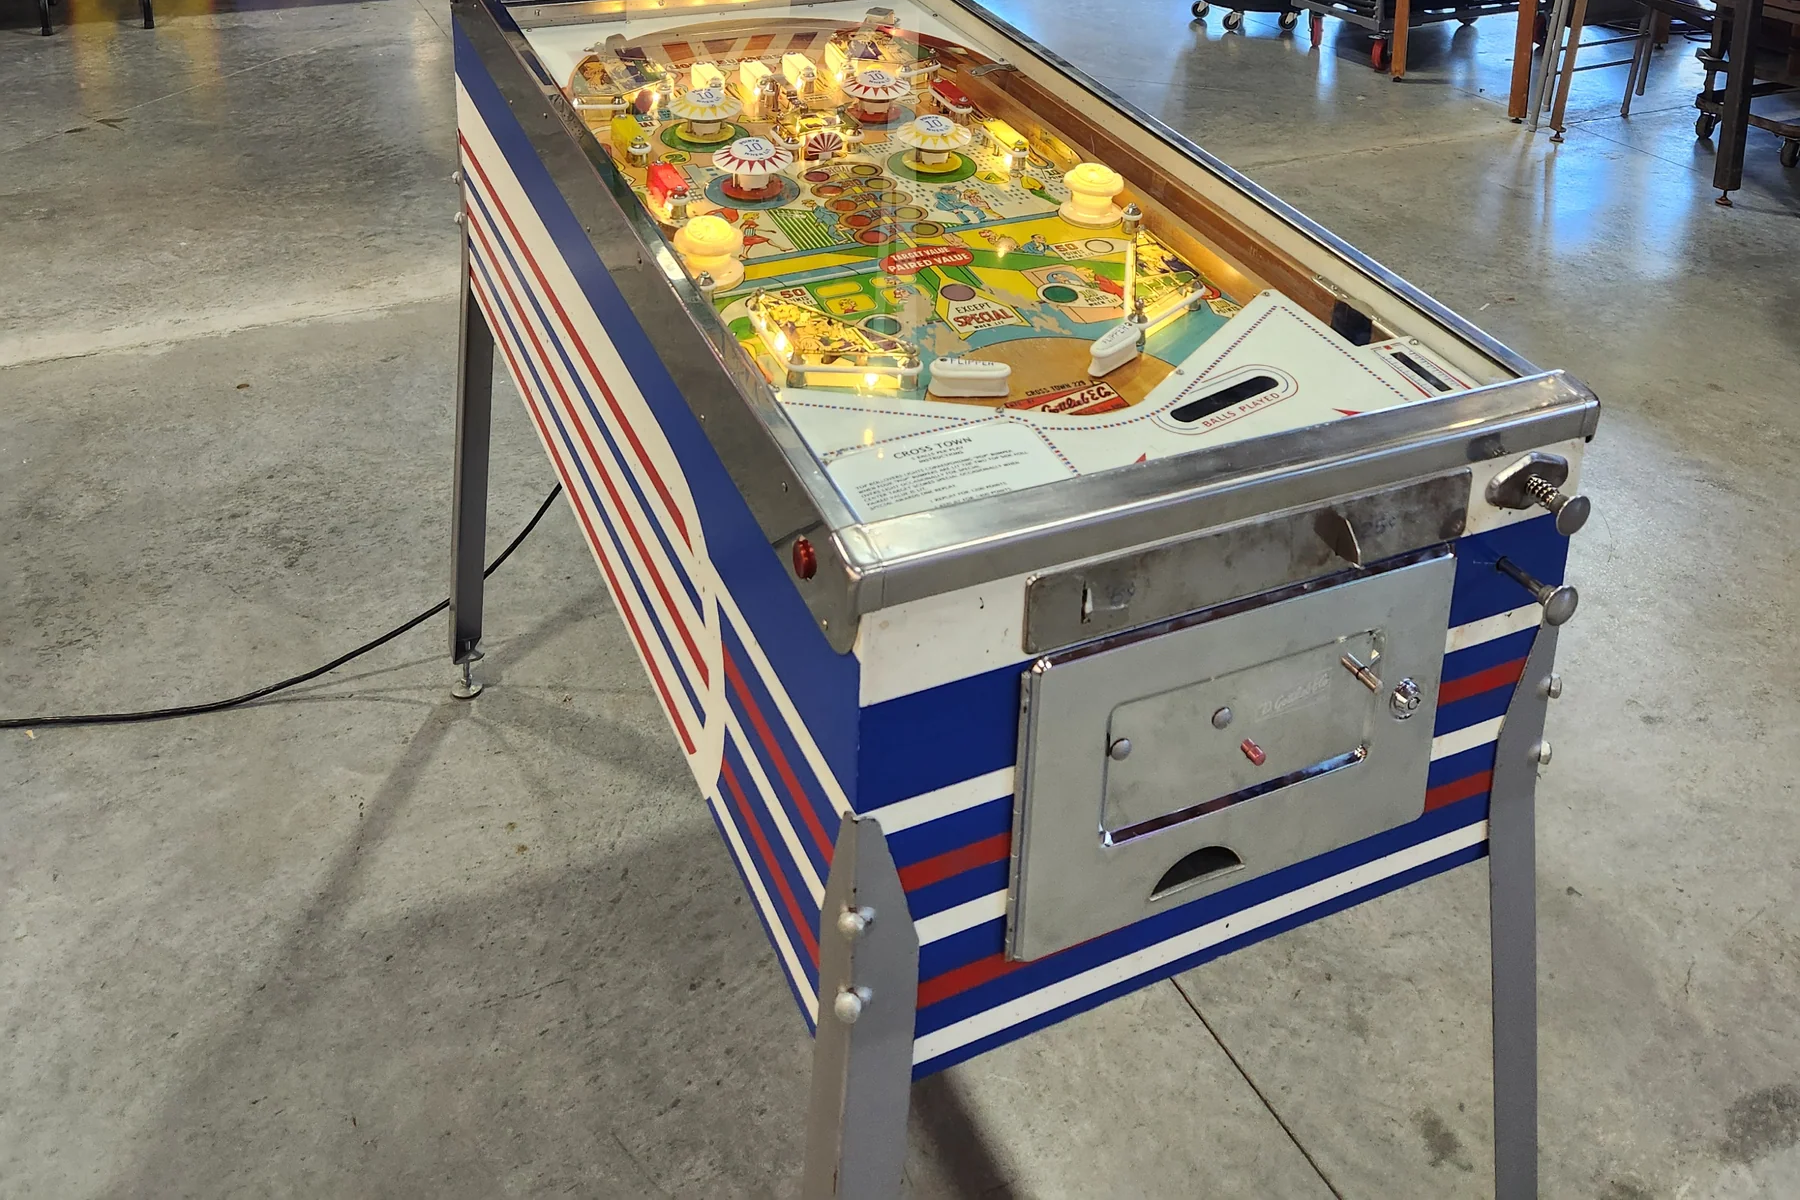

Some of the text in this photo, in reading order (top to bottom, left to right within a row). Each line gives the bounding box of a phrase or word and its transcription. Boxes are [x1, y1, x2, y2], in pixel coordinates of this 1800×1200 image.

[868, 72, 885, 81] 10
[696, 91, 714, 100] 10
[925, 119, 943, 128] 10
[744, 142, 763, 152] 10
[1054, 243, 1079, 252] 50
[891, 246, 950, 262] TARGET VALUE
[888, 252, 970, 273] PAIRED VALUE
[780, 289, 806, 299] 50
[955, 302, 991, 314] EXCEPT
[953, 308, 1014, 328] SPECIAL
[1025, 387, 1050, 397] CROSS
[1051, 383, 1072, 392] TOWN
[1201, 392, 1280, 428] BALLS PLAYED
[893, 436, 973, 460] CROSS TOWN
